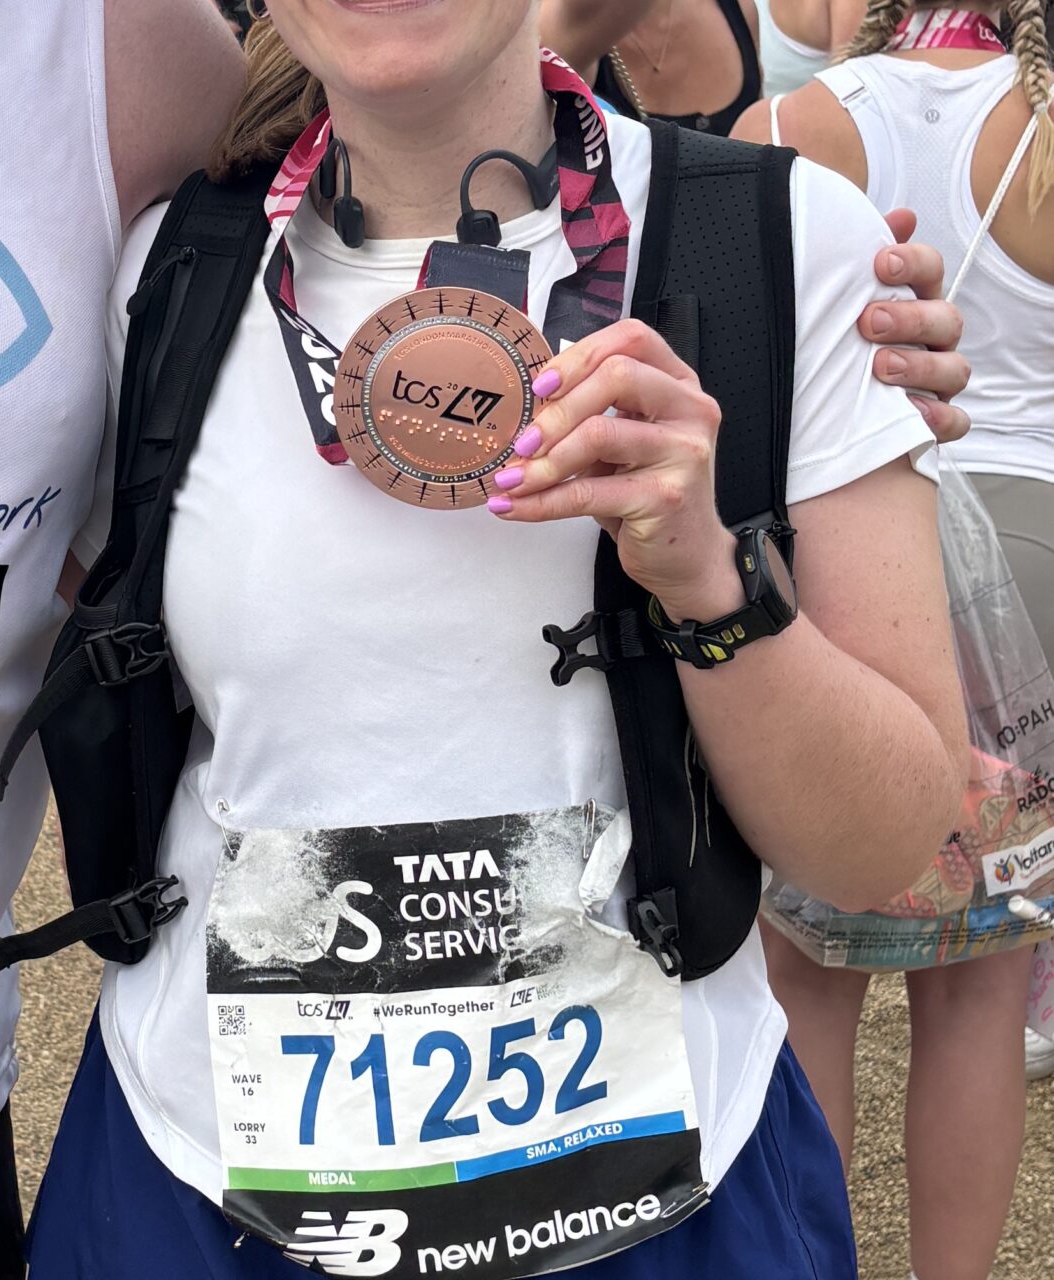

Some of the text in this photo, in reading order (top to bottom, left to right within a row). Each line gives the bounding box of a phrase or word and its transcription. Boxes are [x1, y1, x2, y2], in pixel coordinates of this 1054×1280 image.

[393, 370, 442, 409] tcs
[393, 849, 500, 883] TATA
[297, 1000, 323, 1017] tcs
[373, 1000, 495, 1018] #WeRunTogether
[231, 1074, 262, 1085] WAVE
[281, 1005, 608, 1147] 71252
[241, 1086, 254, 1097] 16
[233, 1122, 266, 1134] LORRY
[244, 1134, 258, 1145] 33
[526, 1122, 624, 1160] SMA, RELAXED
[308, 1171, 356, 1186] MEDAL
[417, 1192, 663, 1274] new balance
